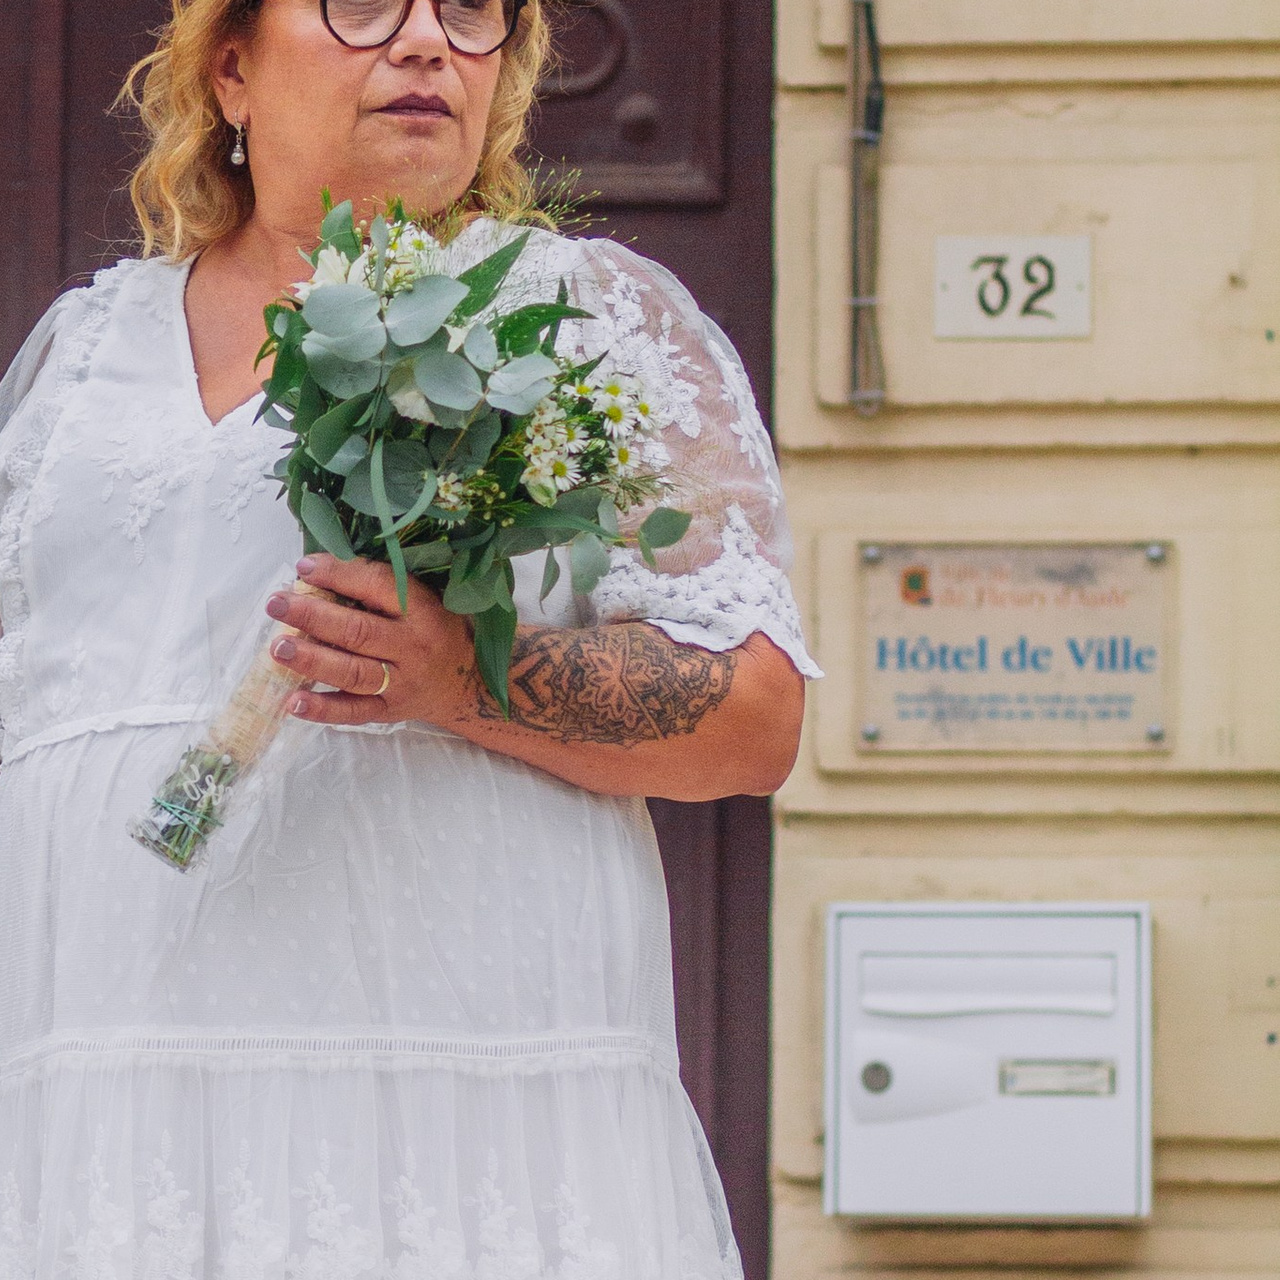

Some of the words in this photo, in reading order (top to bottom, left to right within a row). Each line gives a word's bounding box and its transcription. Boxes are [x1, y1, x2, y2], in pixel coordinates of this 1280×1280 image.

[970, 252, 1056, 319] 32
[876, 634, 988, 671] Hôtel
[1001, 634, 1053, 672] de
[1066, 634, 1157, 672] Ville
